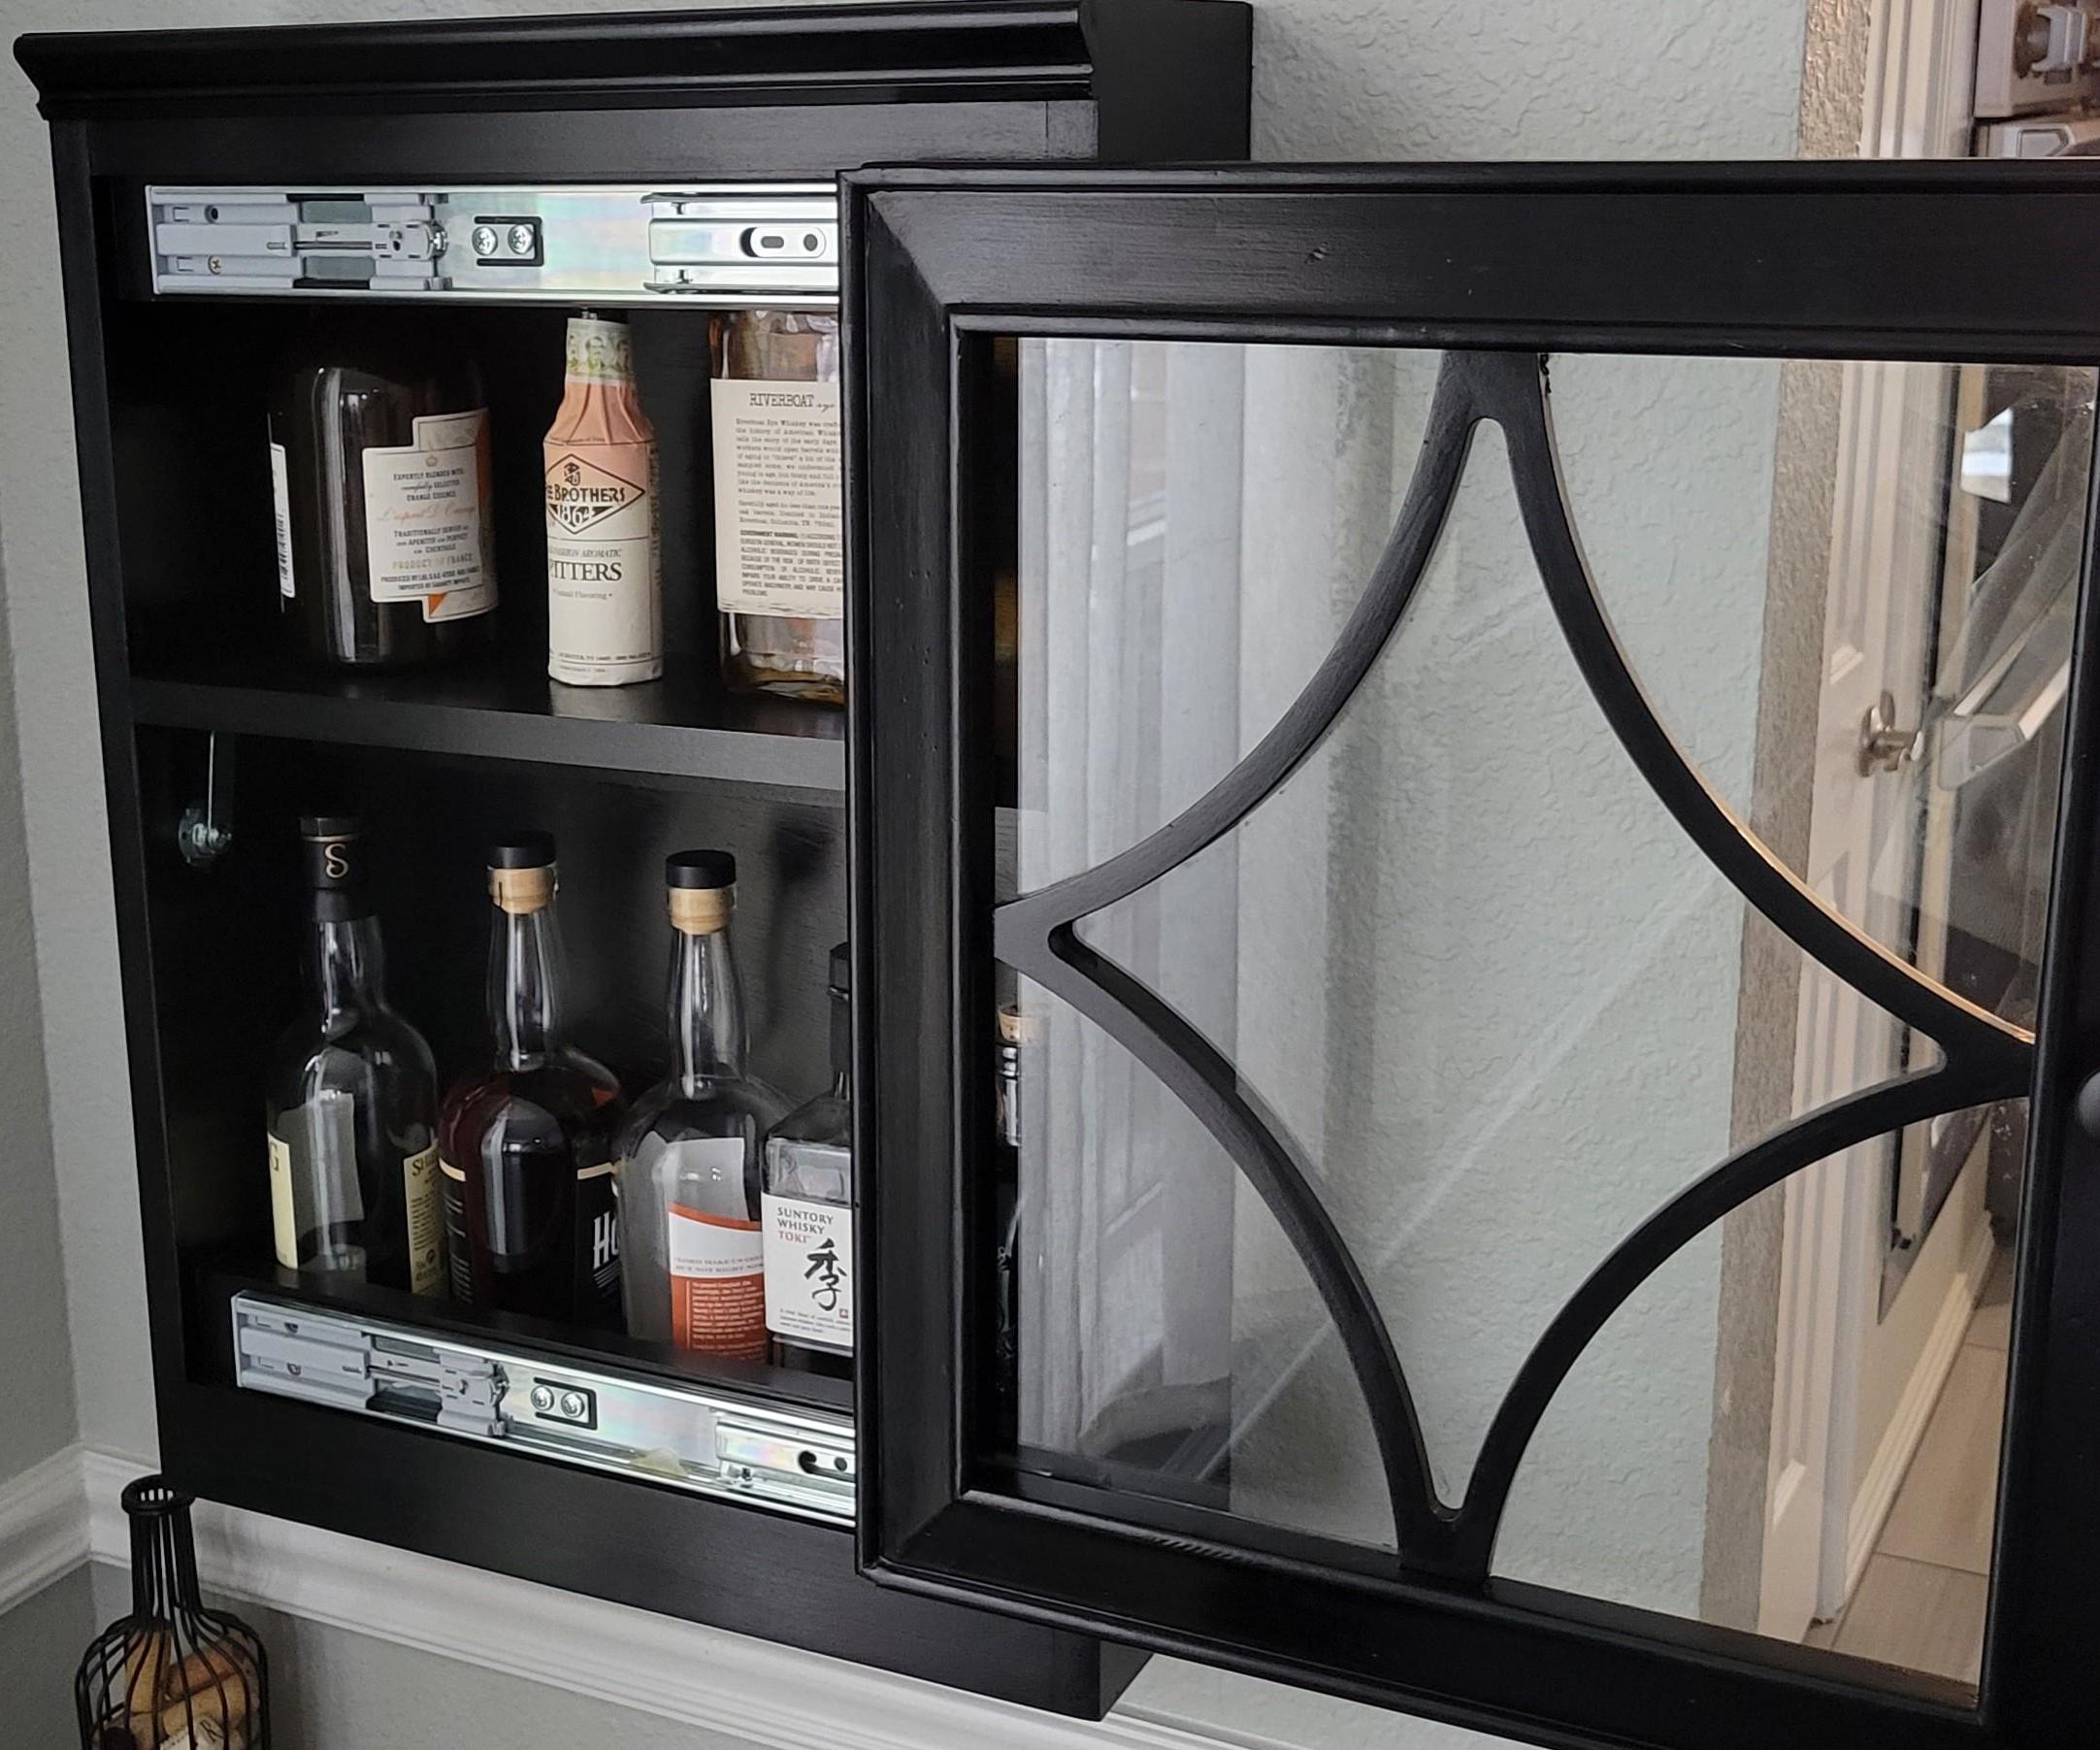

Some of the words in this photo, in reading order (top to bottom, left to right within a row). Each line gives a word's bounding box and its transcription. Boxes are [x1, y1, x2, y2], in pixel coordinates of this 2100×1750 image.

[749, 393, 815, 408] RIVERBOAT
[554, 483, 626, 503] BROTHERS
[324, 842, 349, 878] S
[777, 1206, 834, 1225] SUNTORY
[777, 1218, 825, 1236] WHISKY
